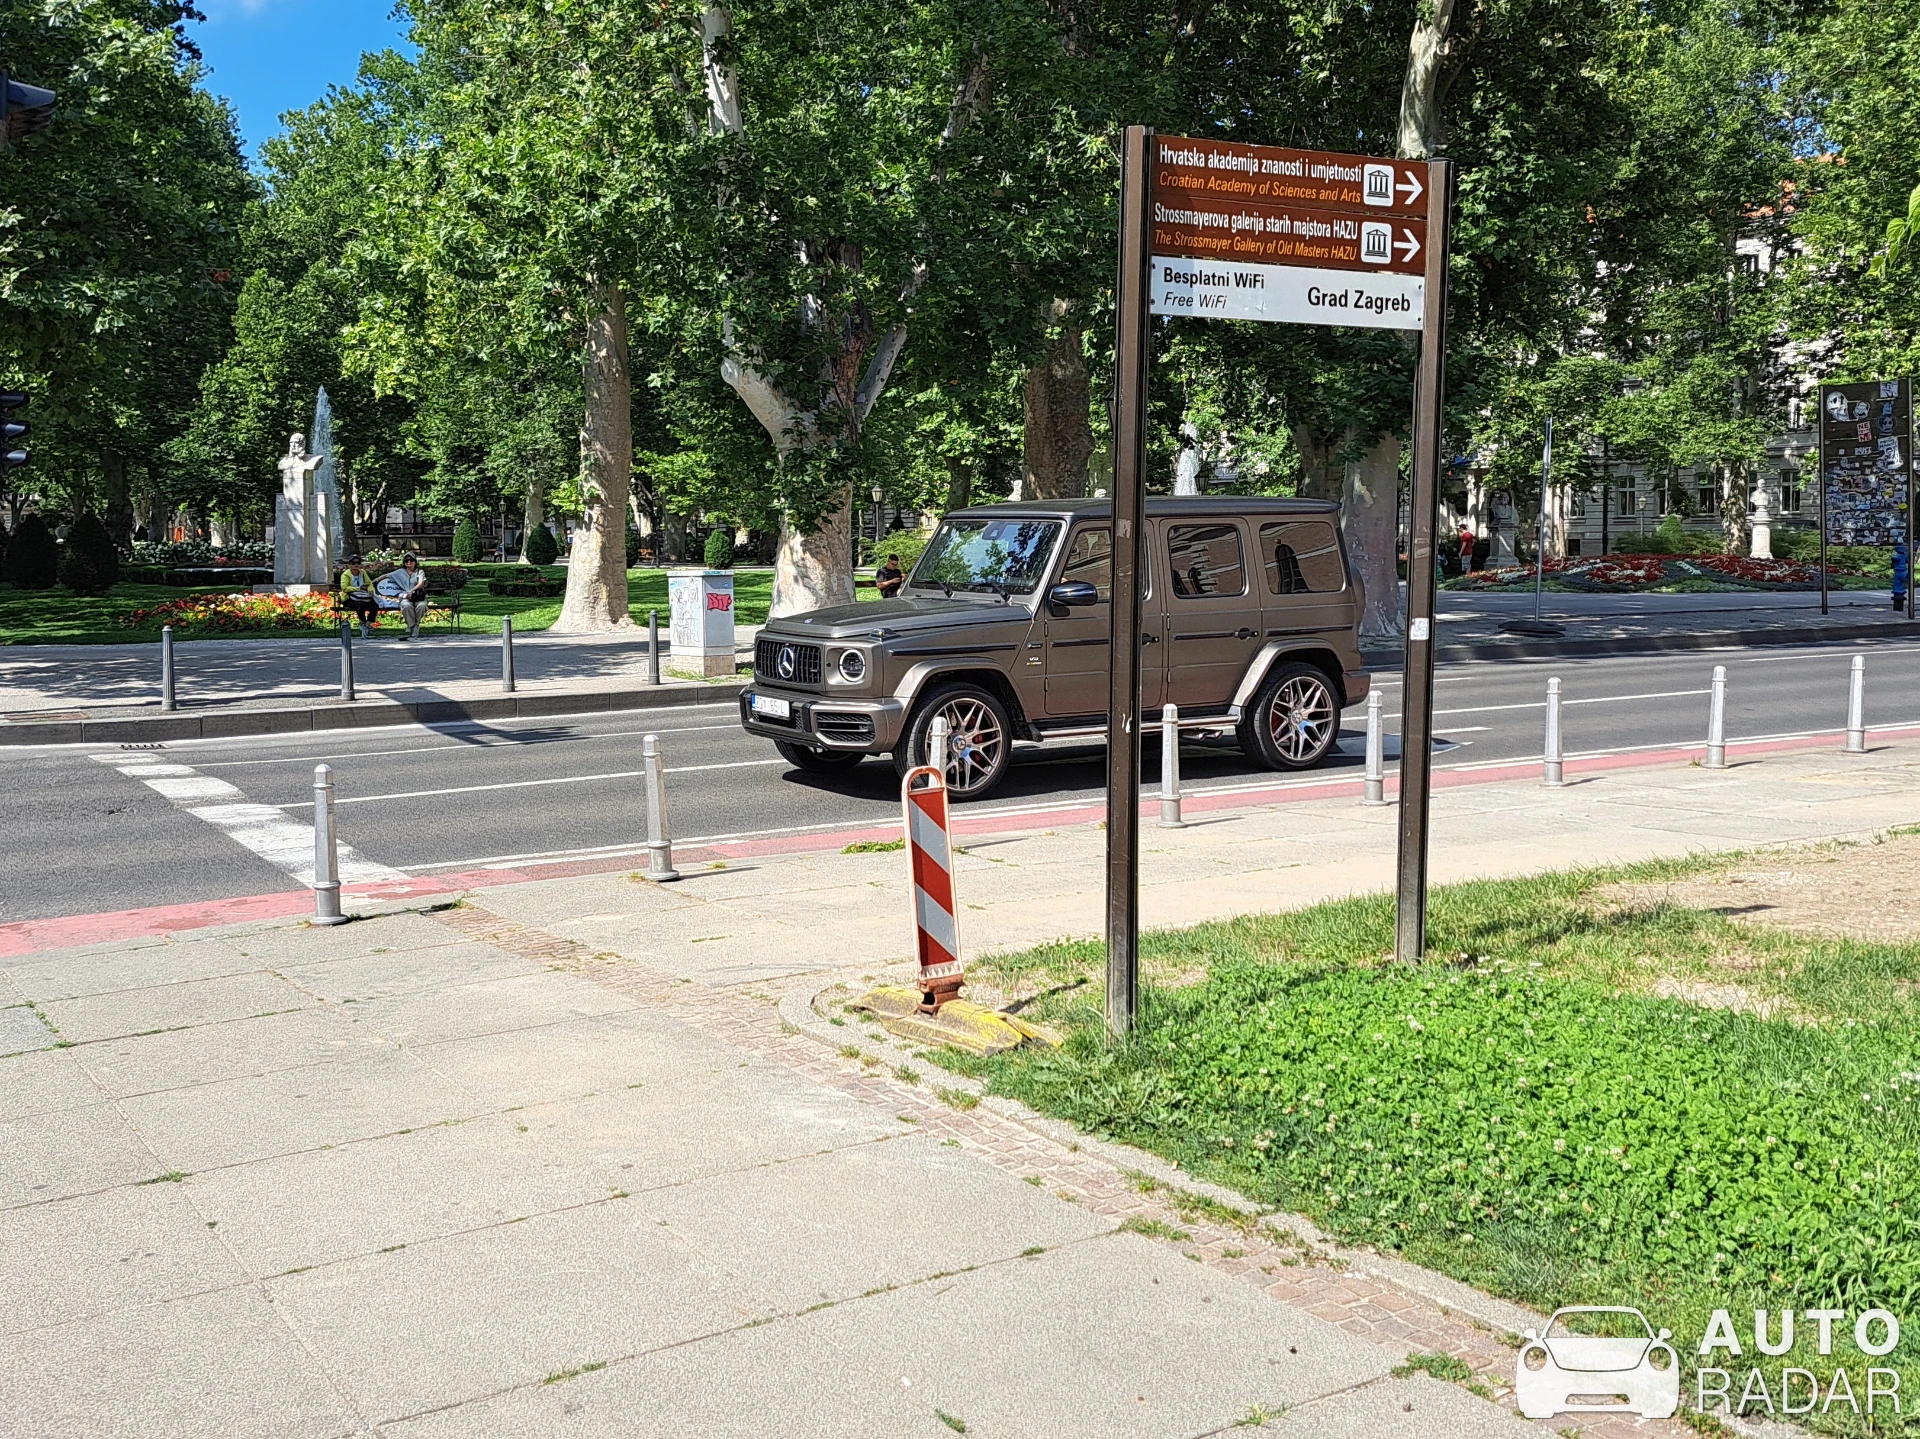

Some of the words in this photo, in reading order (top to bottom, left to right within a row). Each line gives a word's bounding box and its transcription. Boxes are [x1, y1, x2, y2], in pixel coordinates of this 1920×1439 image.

[1160, 143, 1205, 167] Hrvatska
[1208, 149, 1259, 177] akademija
[1261, 158, 1303, 177] znanosti
[1305, 158, 1309, 177] i
[1311, 160, 1362, 184] umjetnosti
[1160, 171, 1205, 189] Croatian
[1207, 175, 1257, 196] Academy
[1259, 180, 1270, 195] of
[1272, 181, 1317, 199] Sciences
[1320, 187, 1339, 201] and
[1340, 187, 1361, 203] Arts
[1154, 202, 1229, 230] Strossmayerova
[1231, 210, 1264, 236] galerija
[1266, 214, 1291, 234] starih
[1293, 216, 1331, 240] majstora
[1333, 218, 1358, 240] HAZU
[1155, 229, 1172, 245] The
[1174, 231, 1232, 252] Strossmayer
[1233, 236, 1265, 256] Gallery
[1266, 239, 1277, 254] of
[1278, 240, 1294, 255] Old
[1294, 241, 1329, 258] Masters
[1331, 244, 1358, 261] HAZU
[1163, 266, 1229, 288] Besplatni
[1234, 271, 1265, 289] WiFi
[1163, 291, 1194, 307] Free
[1199, 293, 1228, 309] WiFi
[1307, 286, 1348, 308] Grad
[1353, 289, 1411, 315] Zagreb
